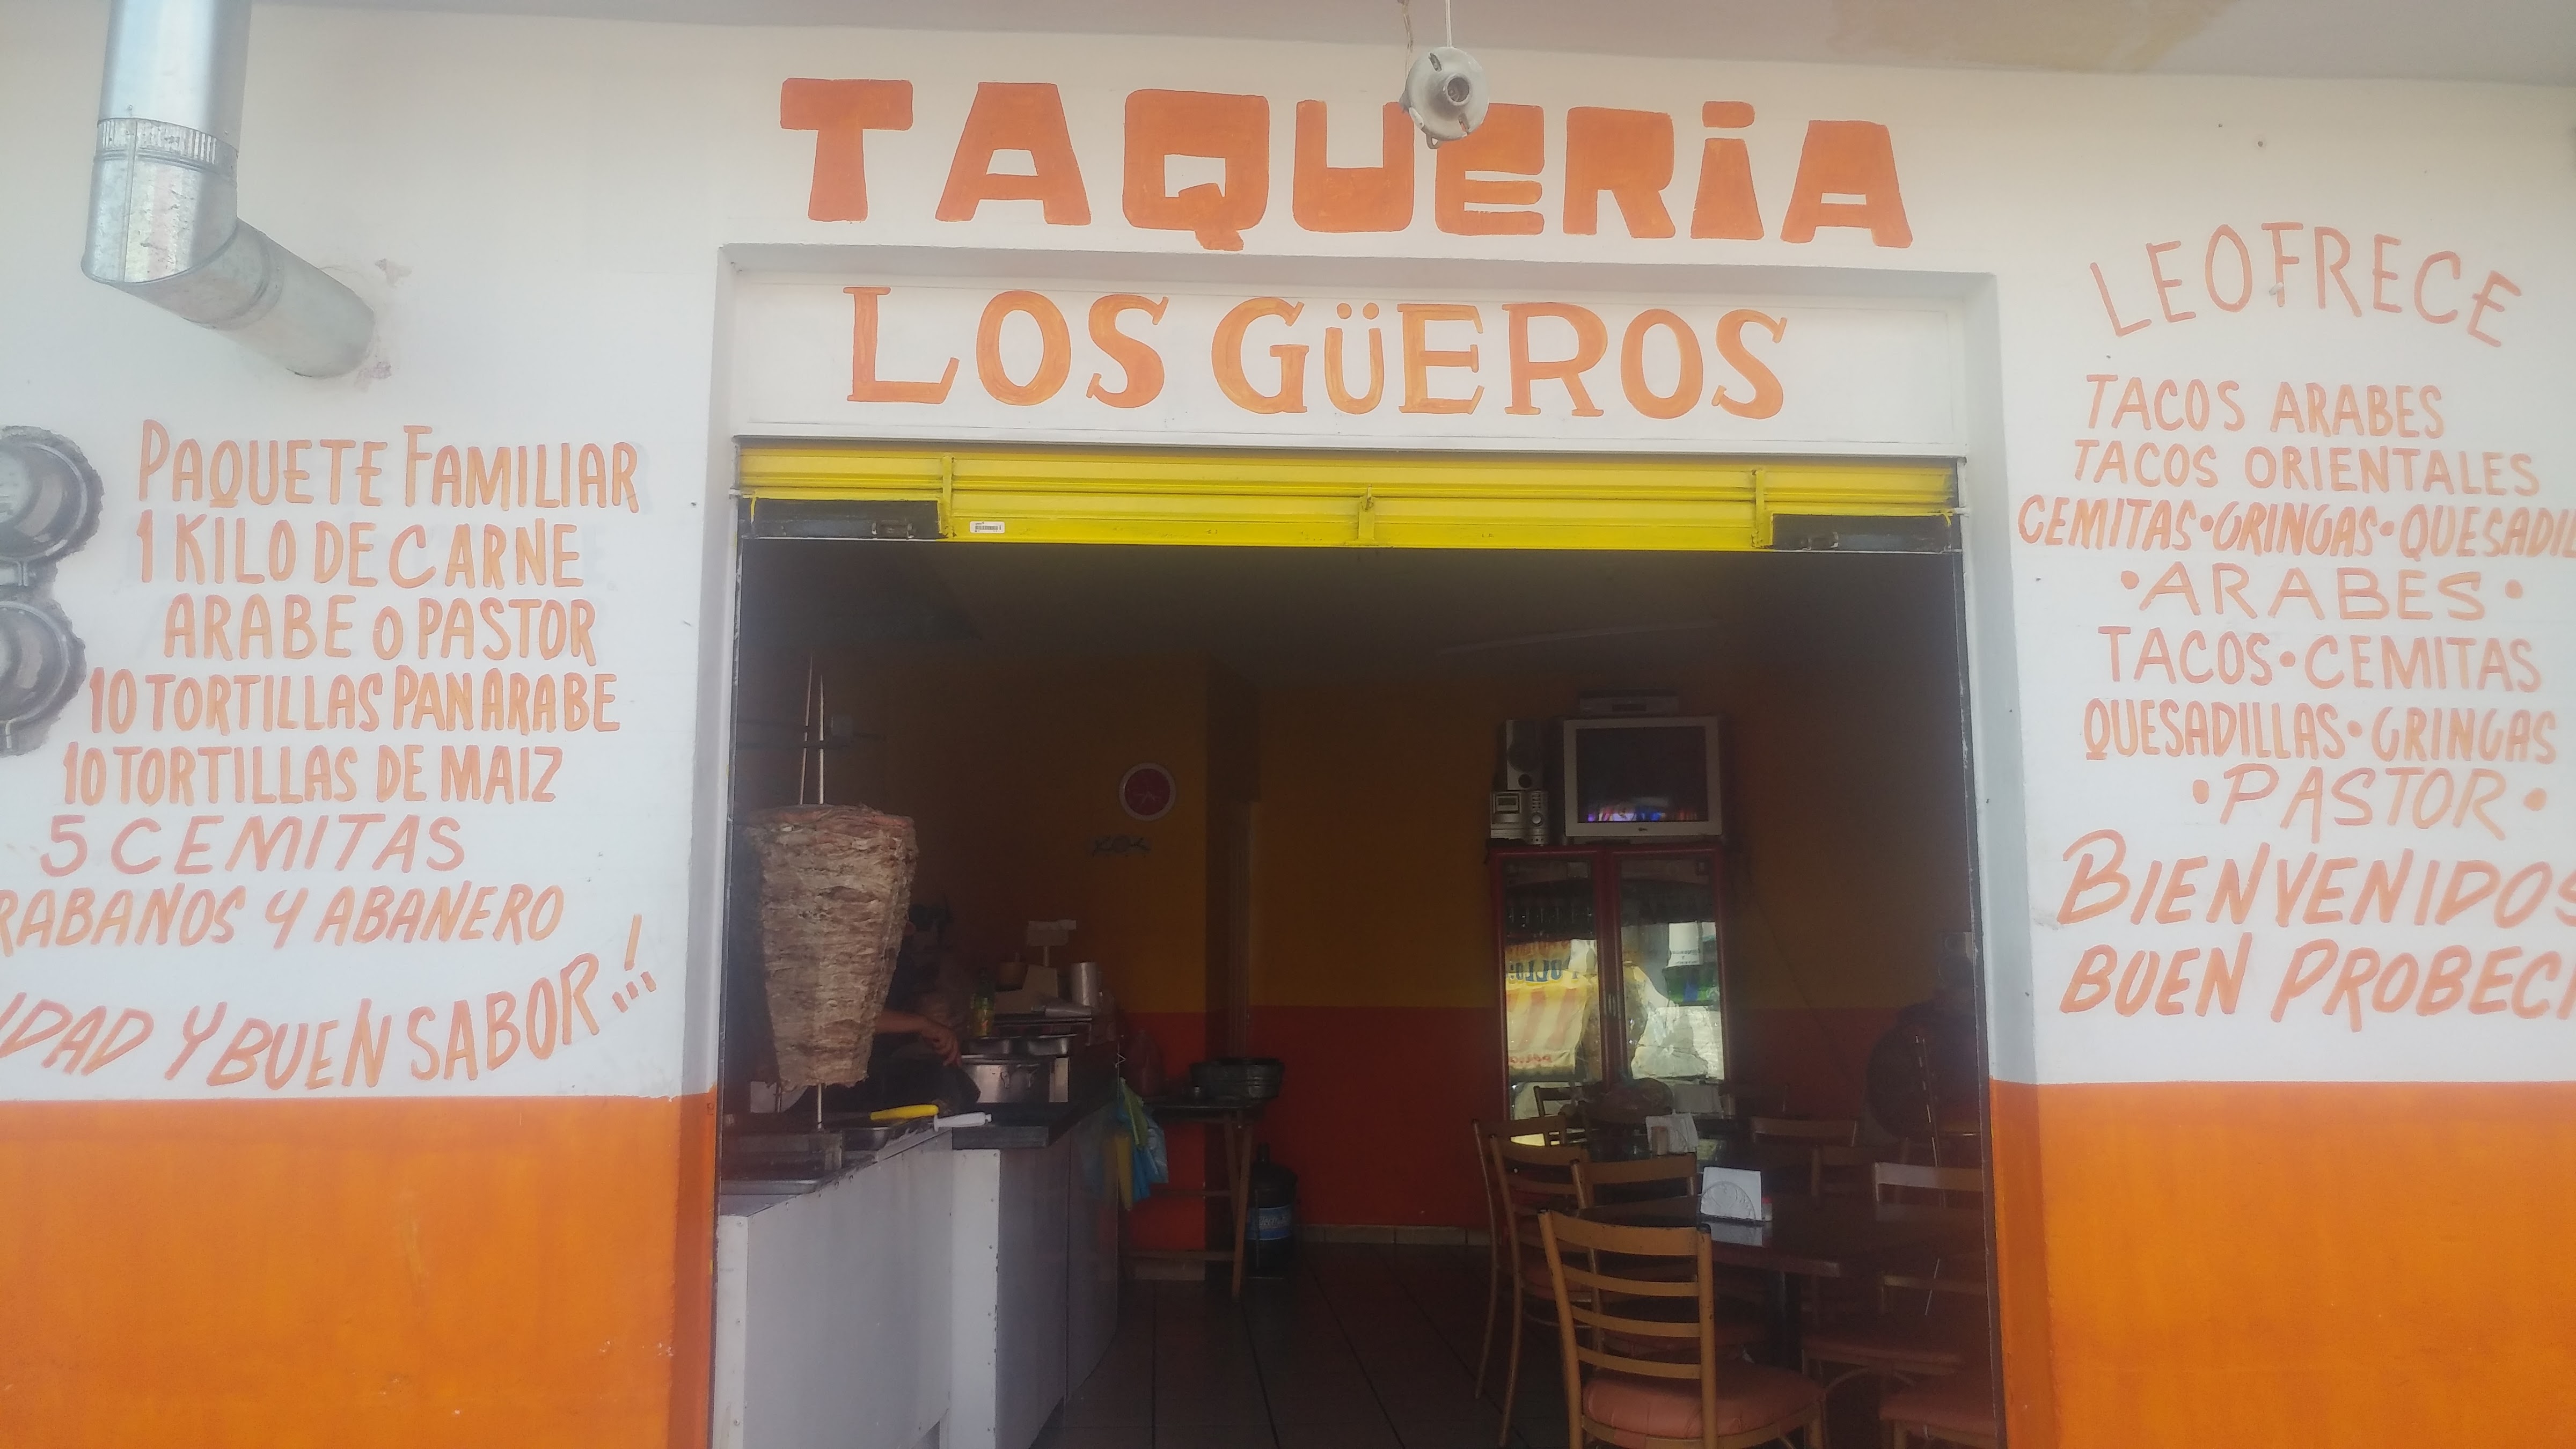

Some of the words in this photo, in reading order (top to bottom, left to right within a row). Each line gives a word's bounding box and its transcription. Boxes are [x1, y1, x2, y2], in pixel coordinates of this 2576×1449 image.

[843, 286, 1169, 408] LOS
[1211, 296, 1788, 420] GÜEROS
[2086, 374, 2246, 431] TACOS
[2270, 381, 2444, 438] ARABES
[138, 419, 389, 509] PAQUETE
[404, 425, 640, 513] FAMILIAR
[2074, 439, 2218, 488] TACOS
[2244, 445, 2540, 496] ORIENTALES
[136, 509, 153, 583] 1
[175, 513, 298, 586] KILO
[314, 521, 378, 588] DE
[389, 517, 584, 589] CARNE
[164, 592, 356, 661] ARABE
[418, 596, 598, 667] PASTOR
[2098, 626, 2272, 685] TACOS
[2305, 635, 2541, 692] CEMITAS
[145, 670, 383, 736] TORTILLAS
[113, 744, 358, 806] TORTILLAS
[376, 745, 427, 802] DE
[440, 744, 564, 804] MAIZ
[2220, 763, 2507, 843] PASTOR
[40, 815, 88, 877] 5
[111, 813, 465, 875] CEMITAS
[315, 880, 565, 947] ABANERO
[2059, 932, 2253, 1017] BUEN
[165, 1001, 227, 1081] Y
[206, 998, 392, 1091] BUEN
